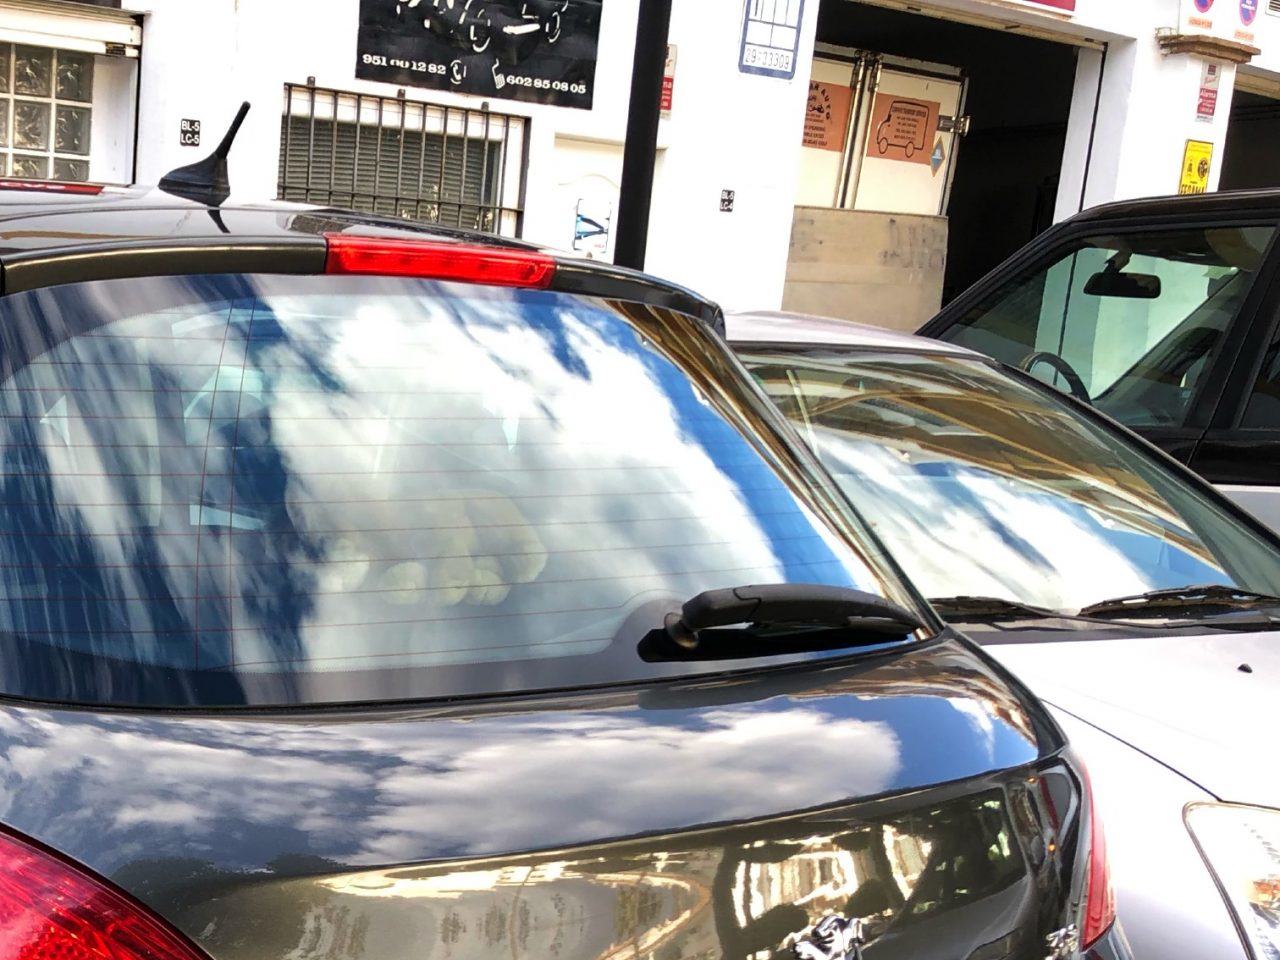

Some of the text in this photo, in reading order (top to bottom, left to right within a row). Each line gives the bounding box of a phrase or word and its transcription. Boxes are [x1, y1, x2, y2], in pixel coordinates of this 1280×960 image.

[362, 53, 388, 66] 951
[506, 74, 587, 94] 602 85 08 05
[181, 120, 200, 131] BL-5
[181, 133, 200, 144] LC-5
